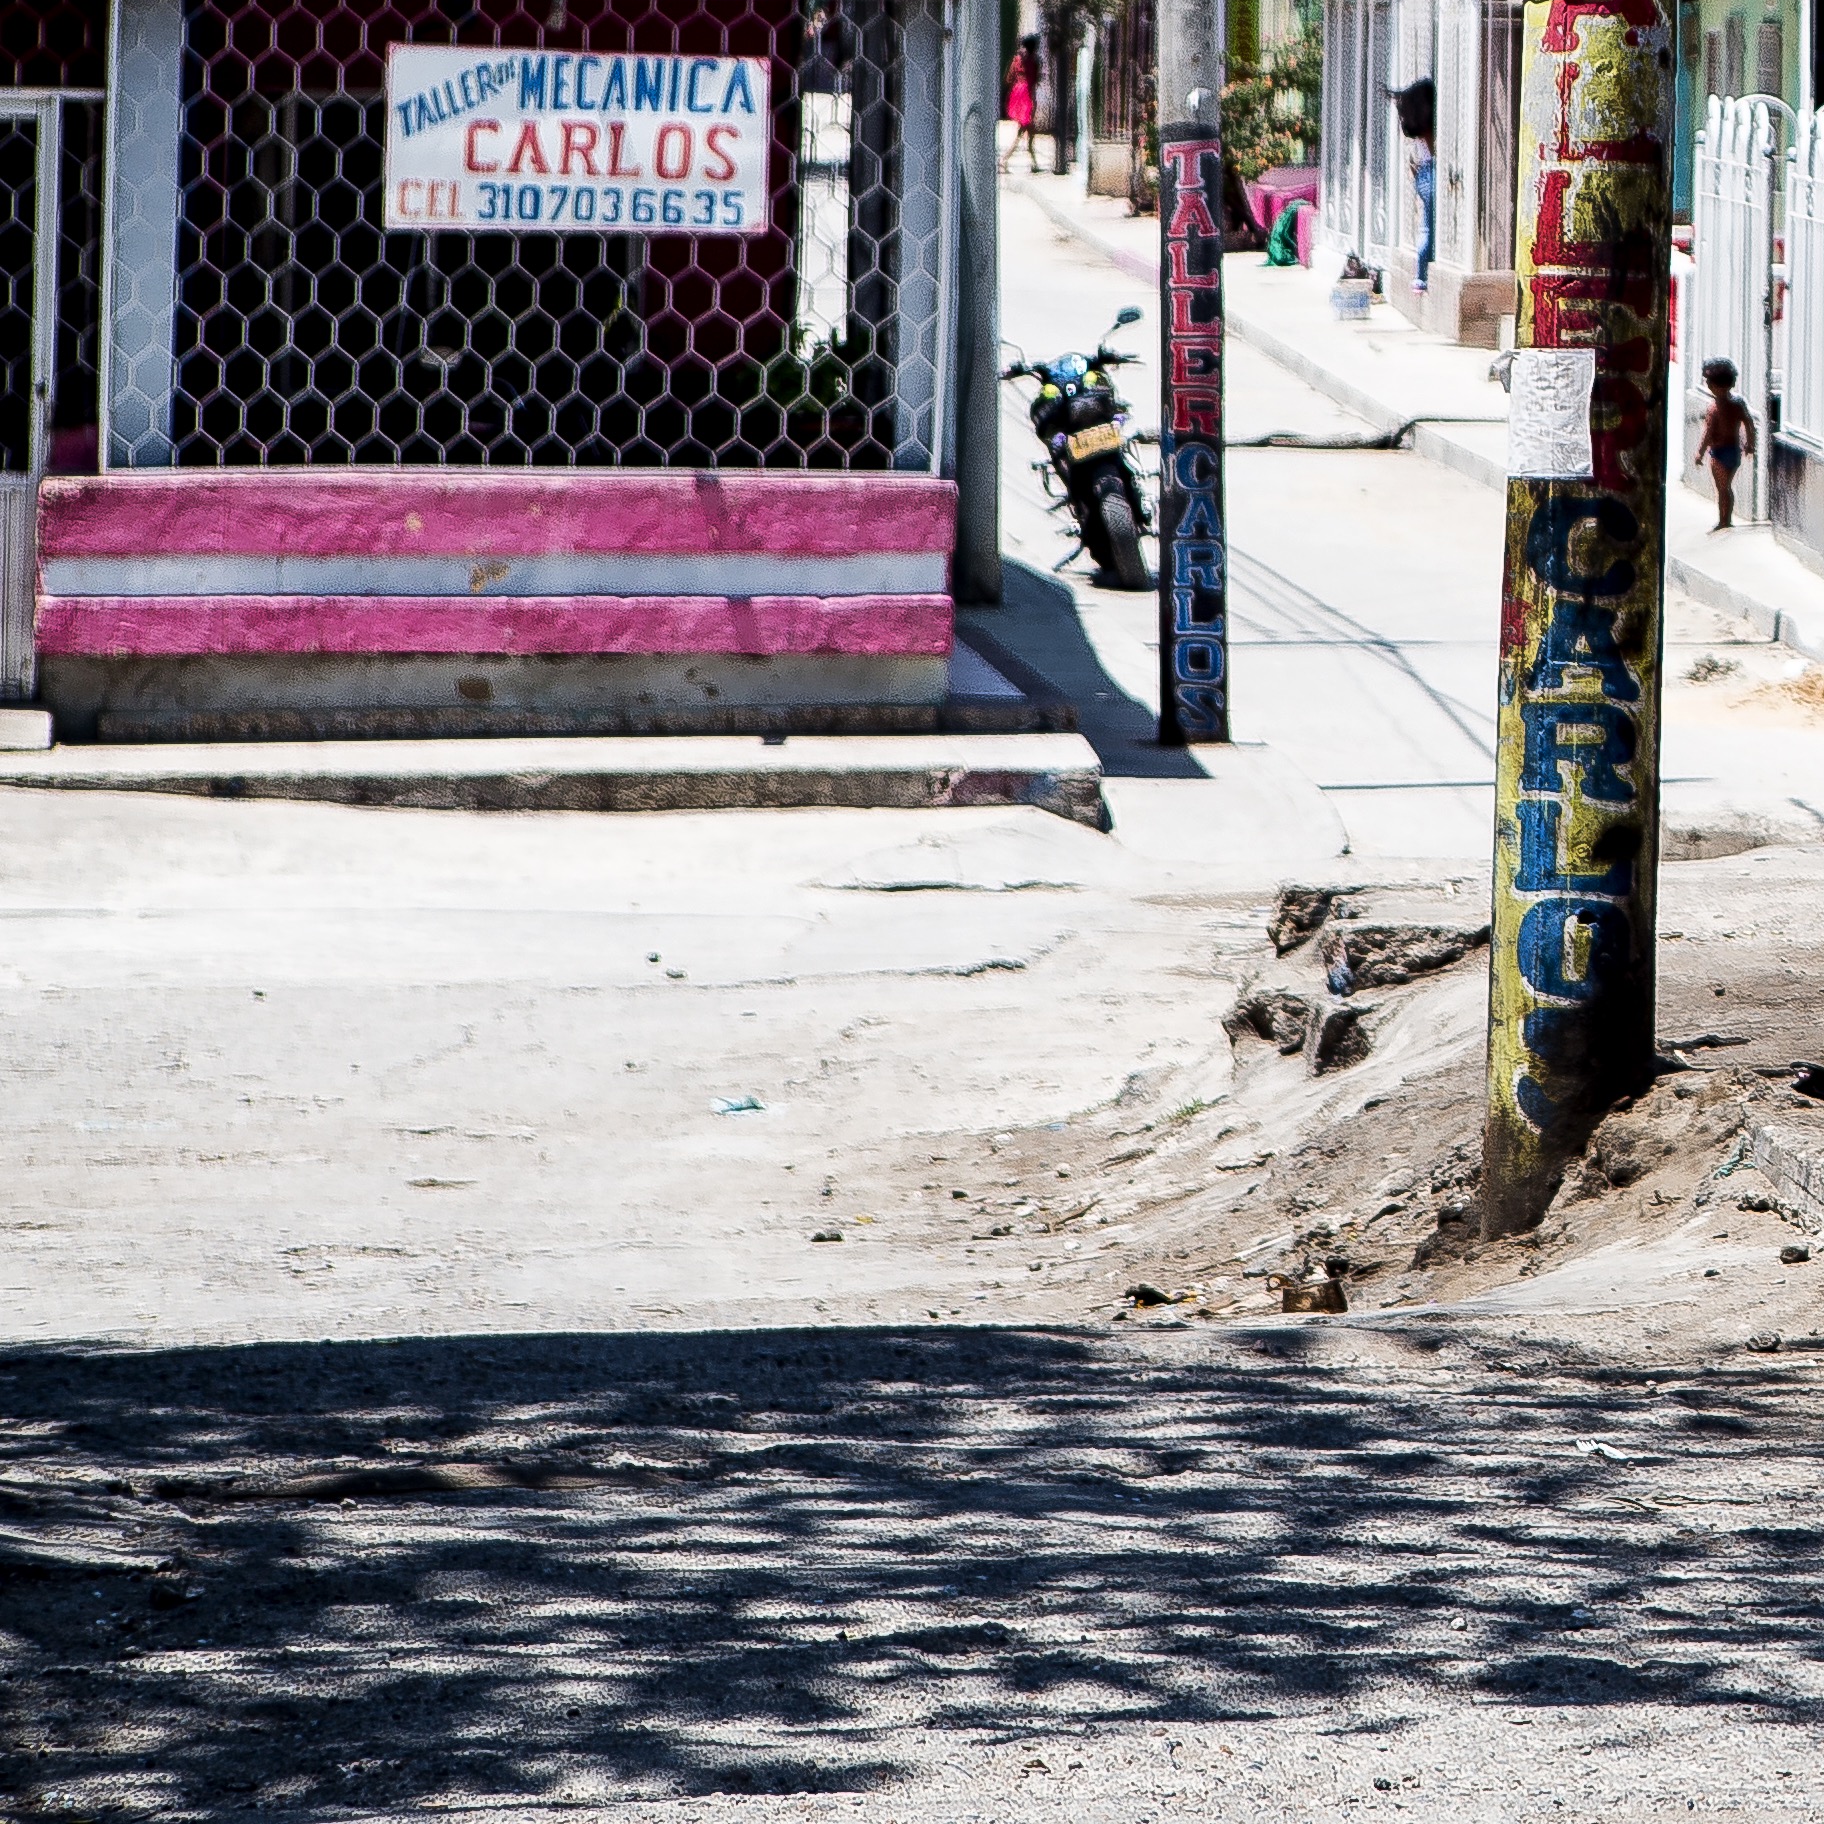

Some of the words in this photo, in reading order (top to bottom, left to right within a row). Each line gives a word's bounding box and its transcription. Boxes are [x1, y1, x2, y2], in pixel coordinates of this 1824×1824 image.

[398, 61, 500, 138] TALLER
[517, 52, 757, 115] MECANICA
[463, 117, 742, 184] CARLOS
[476, 181, 746, 227] 3107036635
[1161, 138, 1222, 440] TALLER
[1174, 440, 1224, 738] CARLOS
